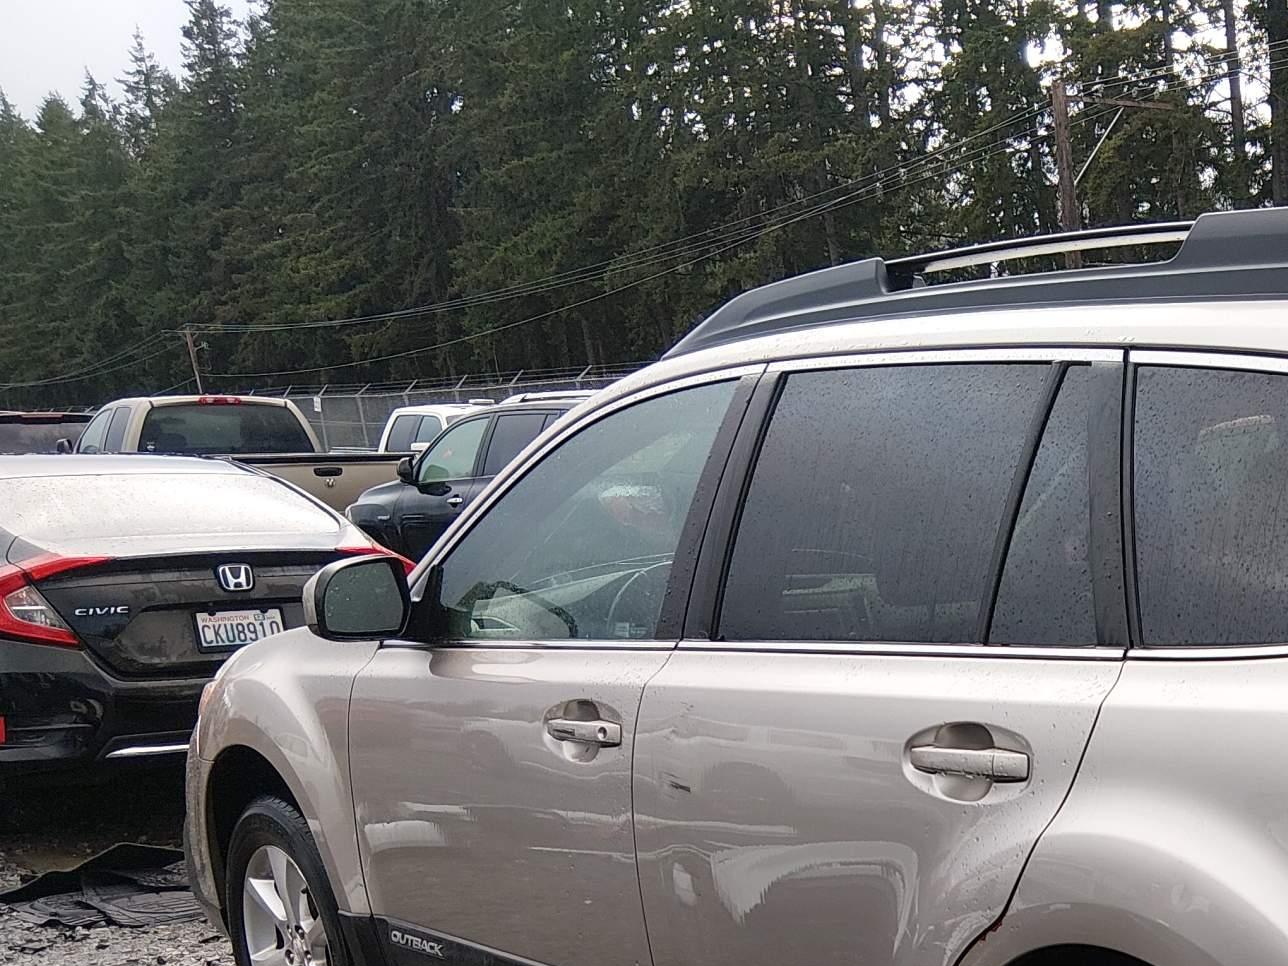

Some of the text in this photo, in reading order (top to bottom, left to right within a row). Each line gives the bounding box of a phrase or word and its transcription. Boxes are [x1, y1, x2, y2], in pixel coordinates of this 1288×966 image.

[74, 605, 129, 616] CIVIC
[200, 614, 250, 624] WASHINGTON
[391, 930, 444, 957] OUTBACK
